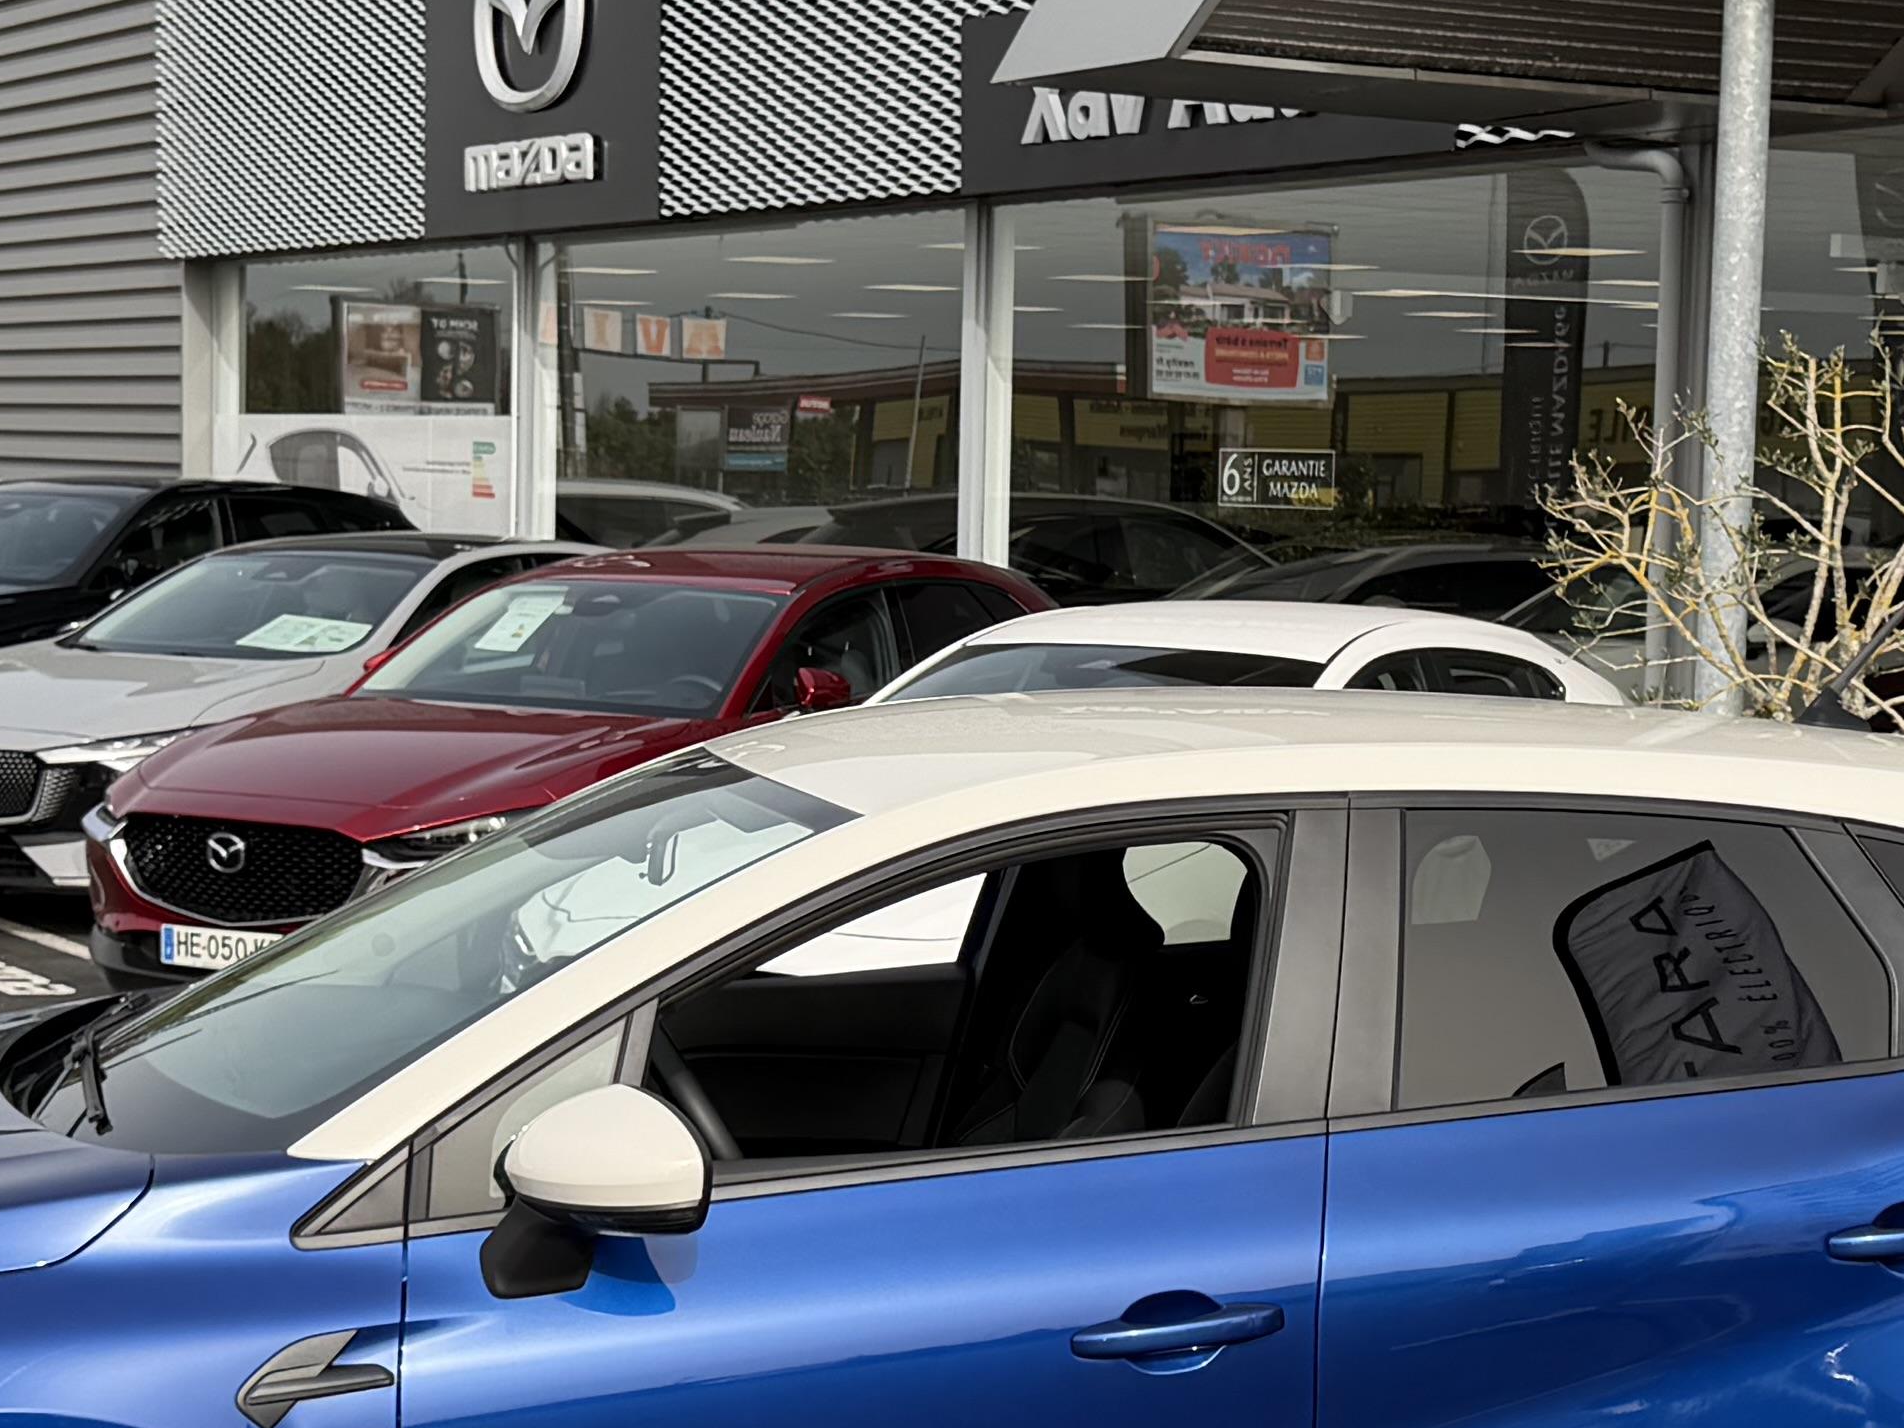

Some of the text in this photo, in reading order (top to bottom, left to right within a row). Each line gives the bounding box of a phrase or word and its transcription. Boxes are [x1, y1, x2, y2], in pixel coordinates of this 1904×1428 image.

[1222, 453, 1240, 495] 6
[1262, 459, 1326, 477] GARANTIE
[1268, 480, 1318, 499] MAZDA
[1629, 895, 1743, 1078] ARA
